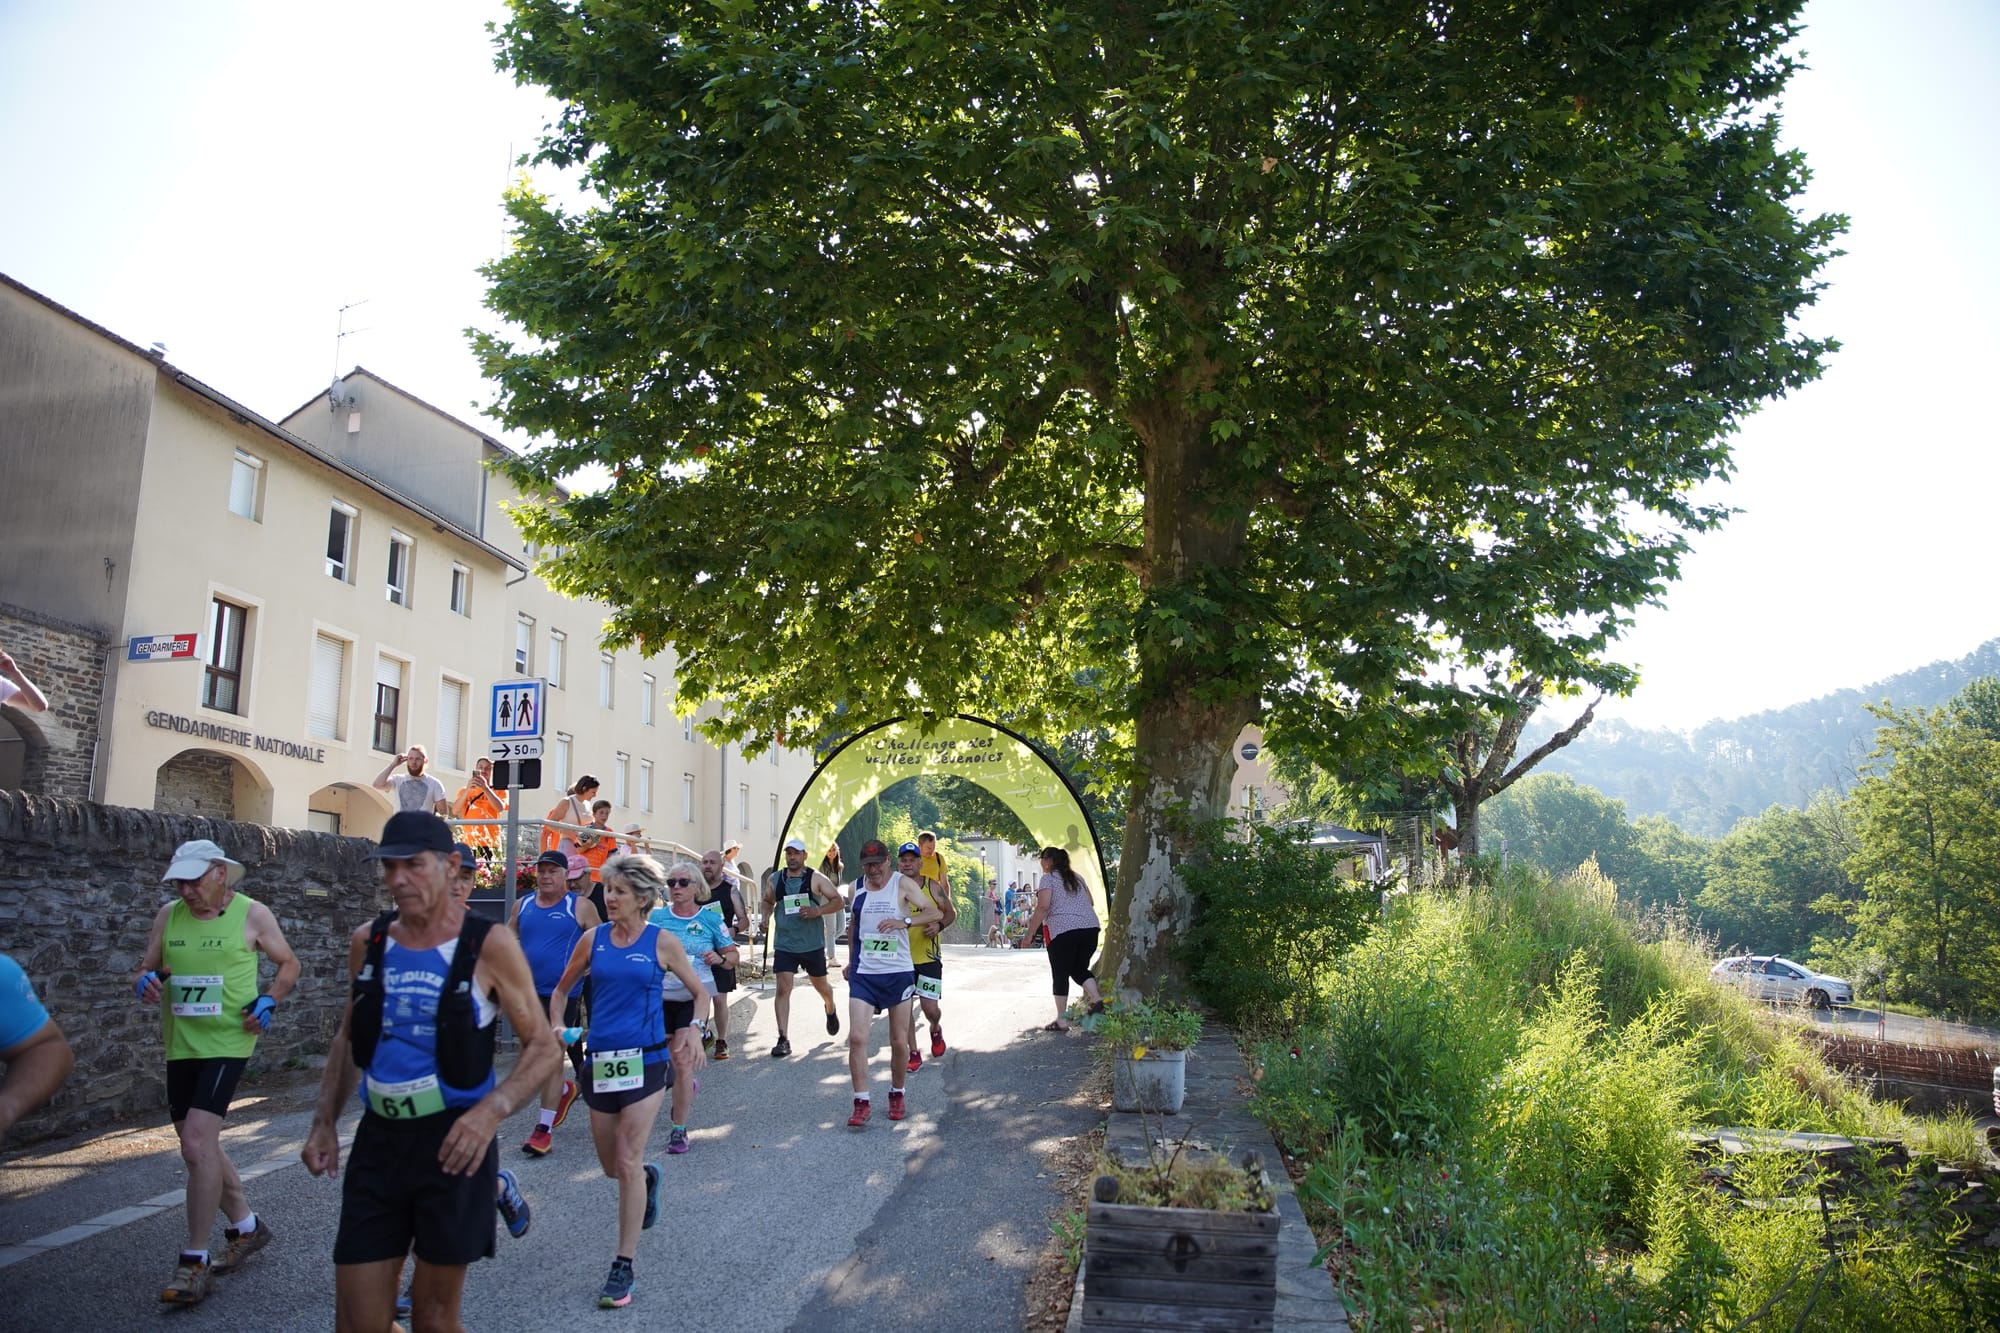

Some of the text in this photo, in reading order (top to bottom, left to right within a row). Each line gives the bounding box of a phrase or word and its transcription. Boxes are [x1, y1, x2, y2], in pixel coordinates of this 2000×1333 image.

[137, 641, 188, 654] GENDARMERIE
[147, 710, 325, 763] GENDARMERIE NATIONALE
[875, 737, 994, 753] Challenge des
[794, 899, 800, 907] 6
[873, 941, 889, 951] 72
[181, 987, 207, 1002] 77
[922, 982, 936, 993] 64
[603, 1060, 629, 1078] 36
[382, 1096, 417, 1118] 61
